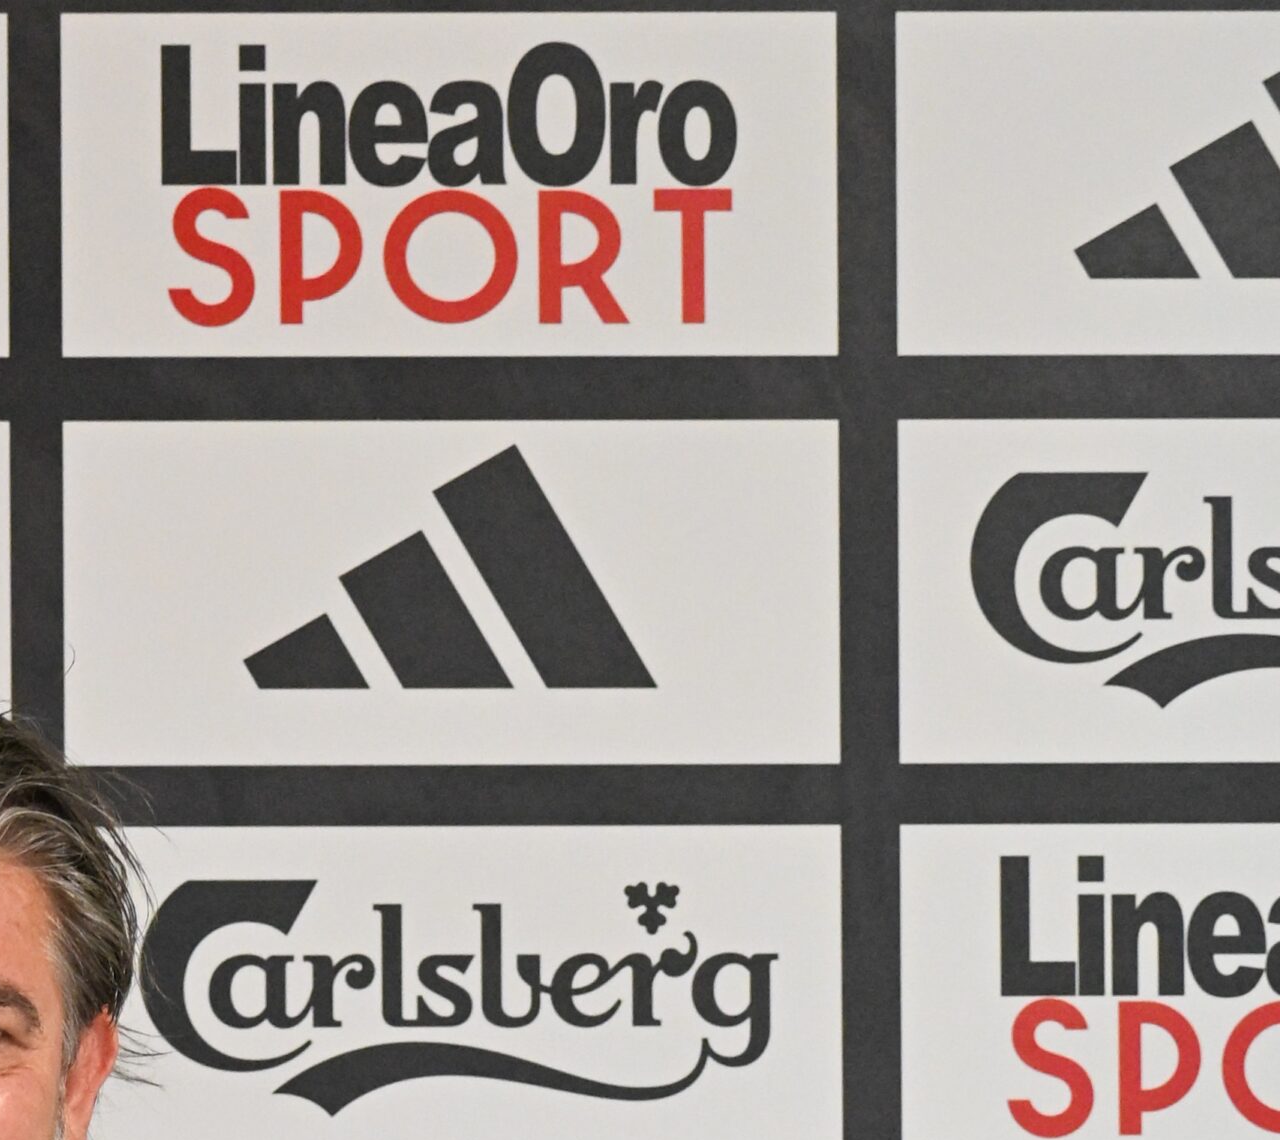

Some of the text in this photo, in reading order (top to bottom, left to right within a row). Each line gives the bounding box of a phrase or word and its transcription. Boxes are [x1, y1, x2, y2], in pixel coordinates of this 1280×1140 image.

[161, 42, 737, 187] LineaOro
[168, 188, 732, 327] SPORT
[140, 880, 778, 1072] Carlsberg
[1000, 856, 1280, 998] Line
